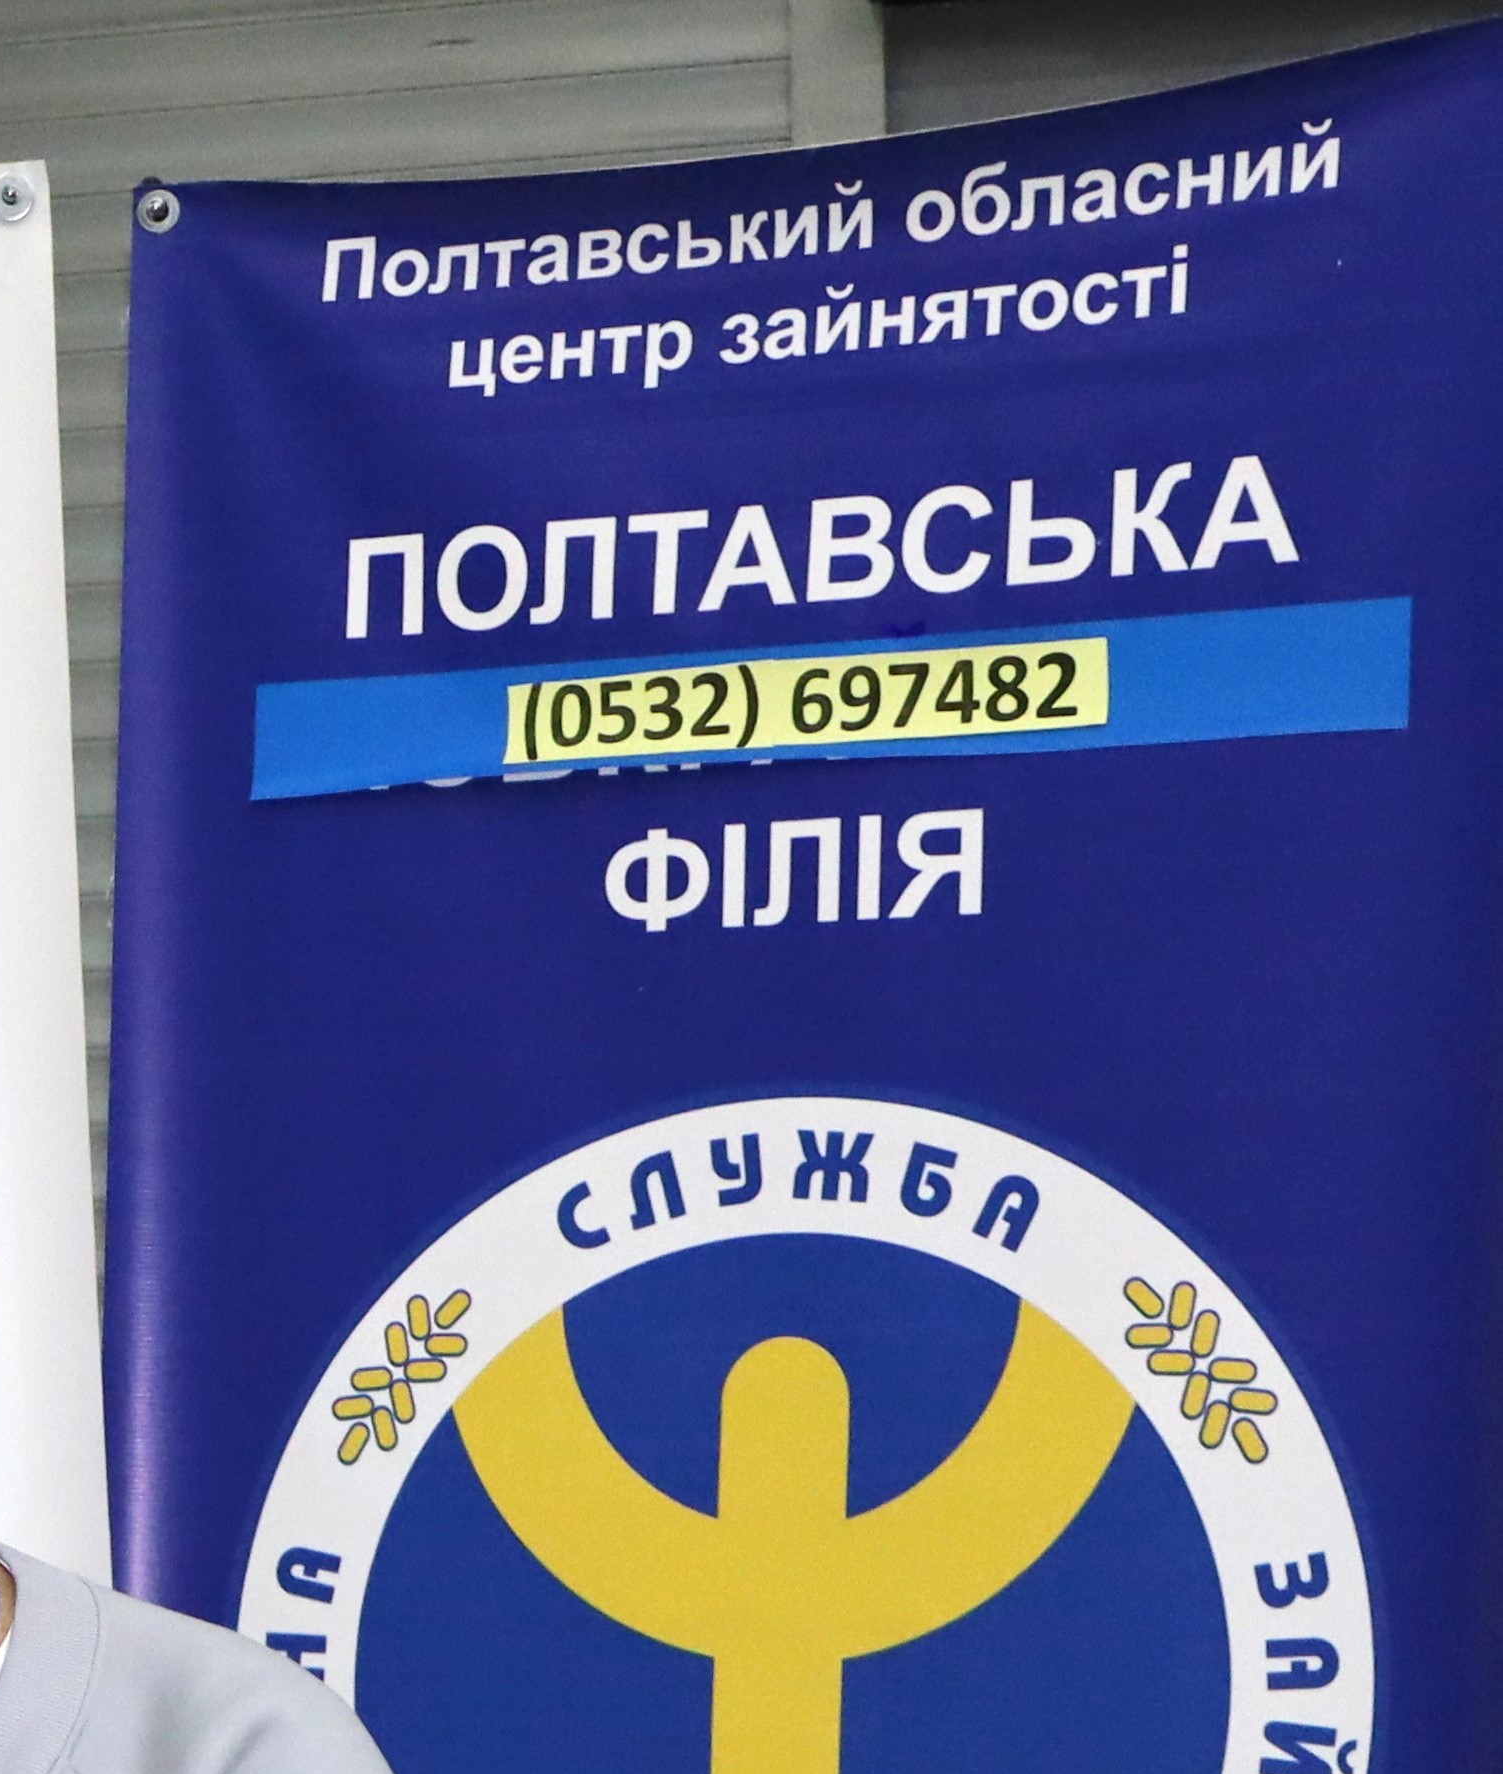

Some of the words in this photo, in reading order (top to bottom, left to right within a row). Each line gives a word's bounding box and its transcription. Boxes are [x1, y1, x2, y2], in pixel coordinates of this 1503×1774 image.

[320, 181, 877, 303] Полтавський
[905, 119, 1342, 243] обласний
[447, 318, 694, 396] центр
[719, 246, 1191, 364] зайнятості
[345, 454, 1300, 639] ПОЛТАВСЬКА
[523, 664, 761, 761] (0532)
[790, 652, 1079, 733] 697482
[604, 807, 985, 933] ФІЛІЯ
[555, 1129, 1041, 1252] СЛУЖБА
